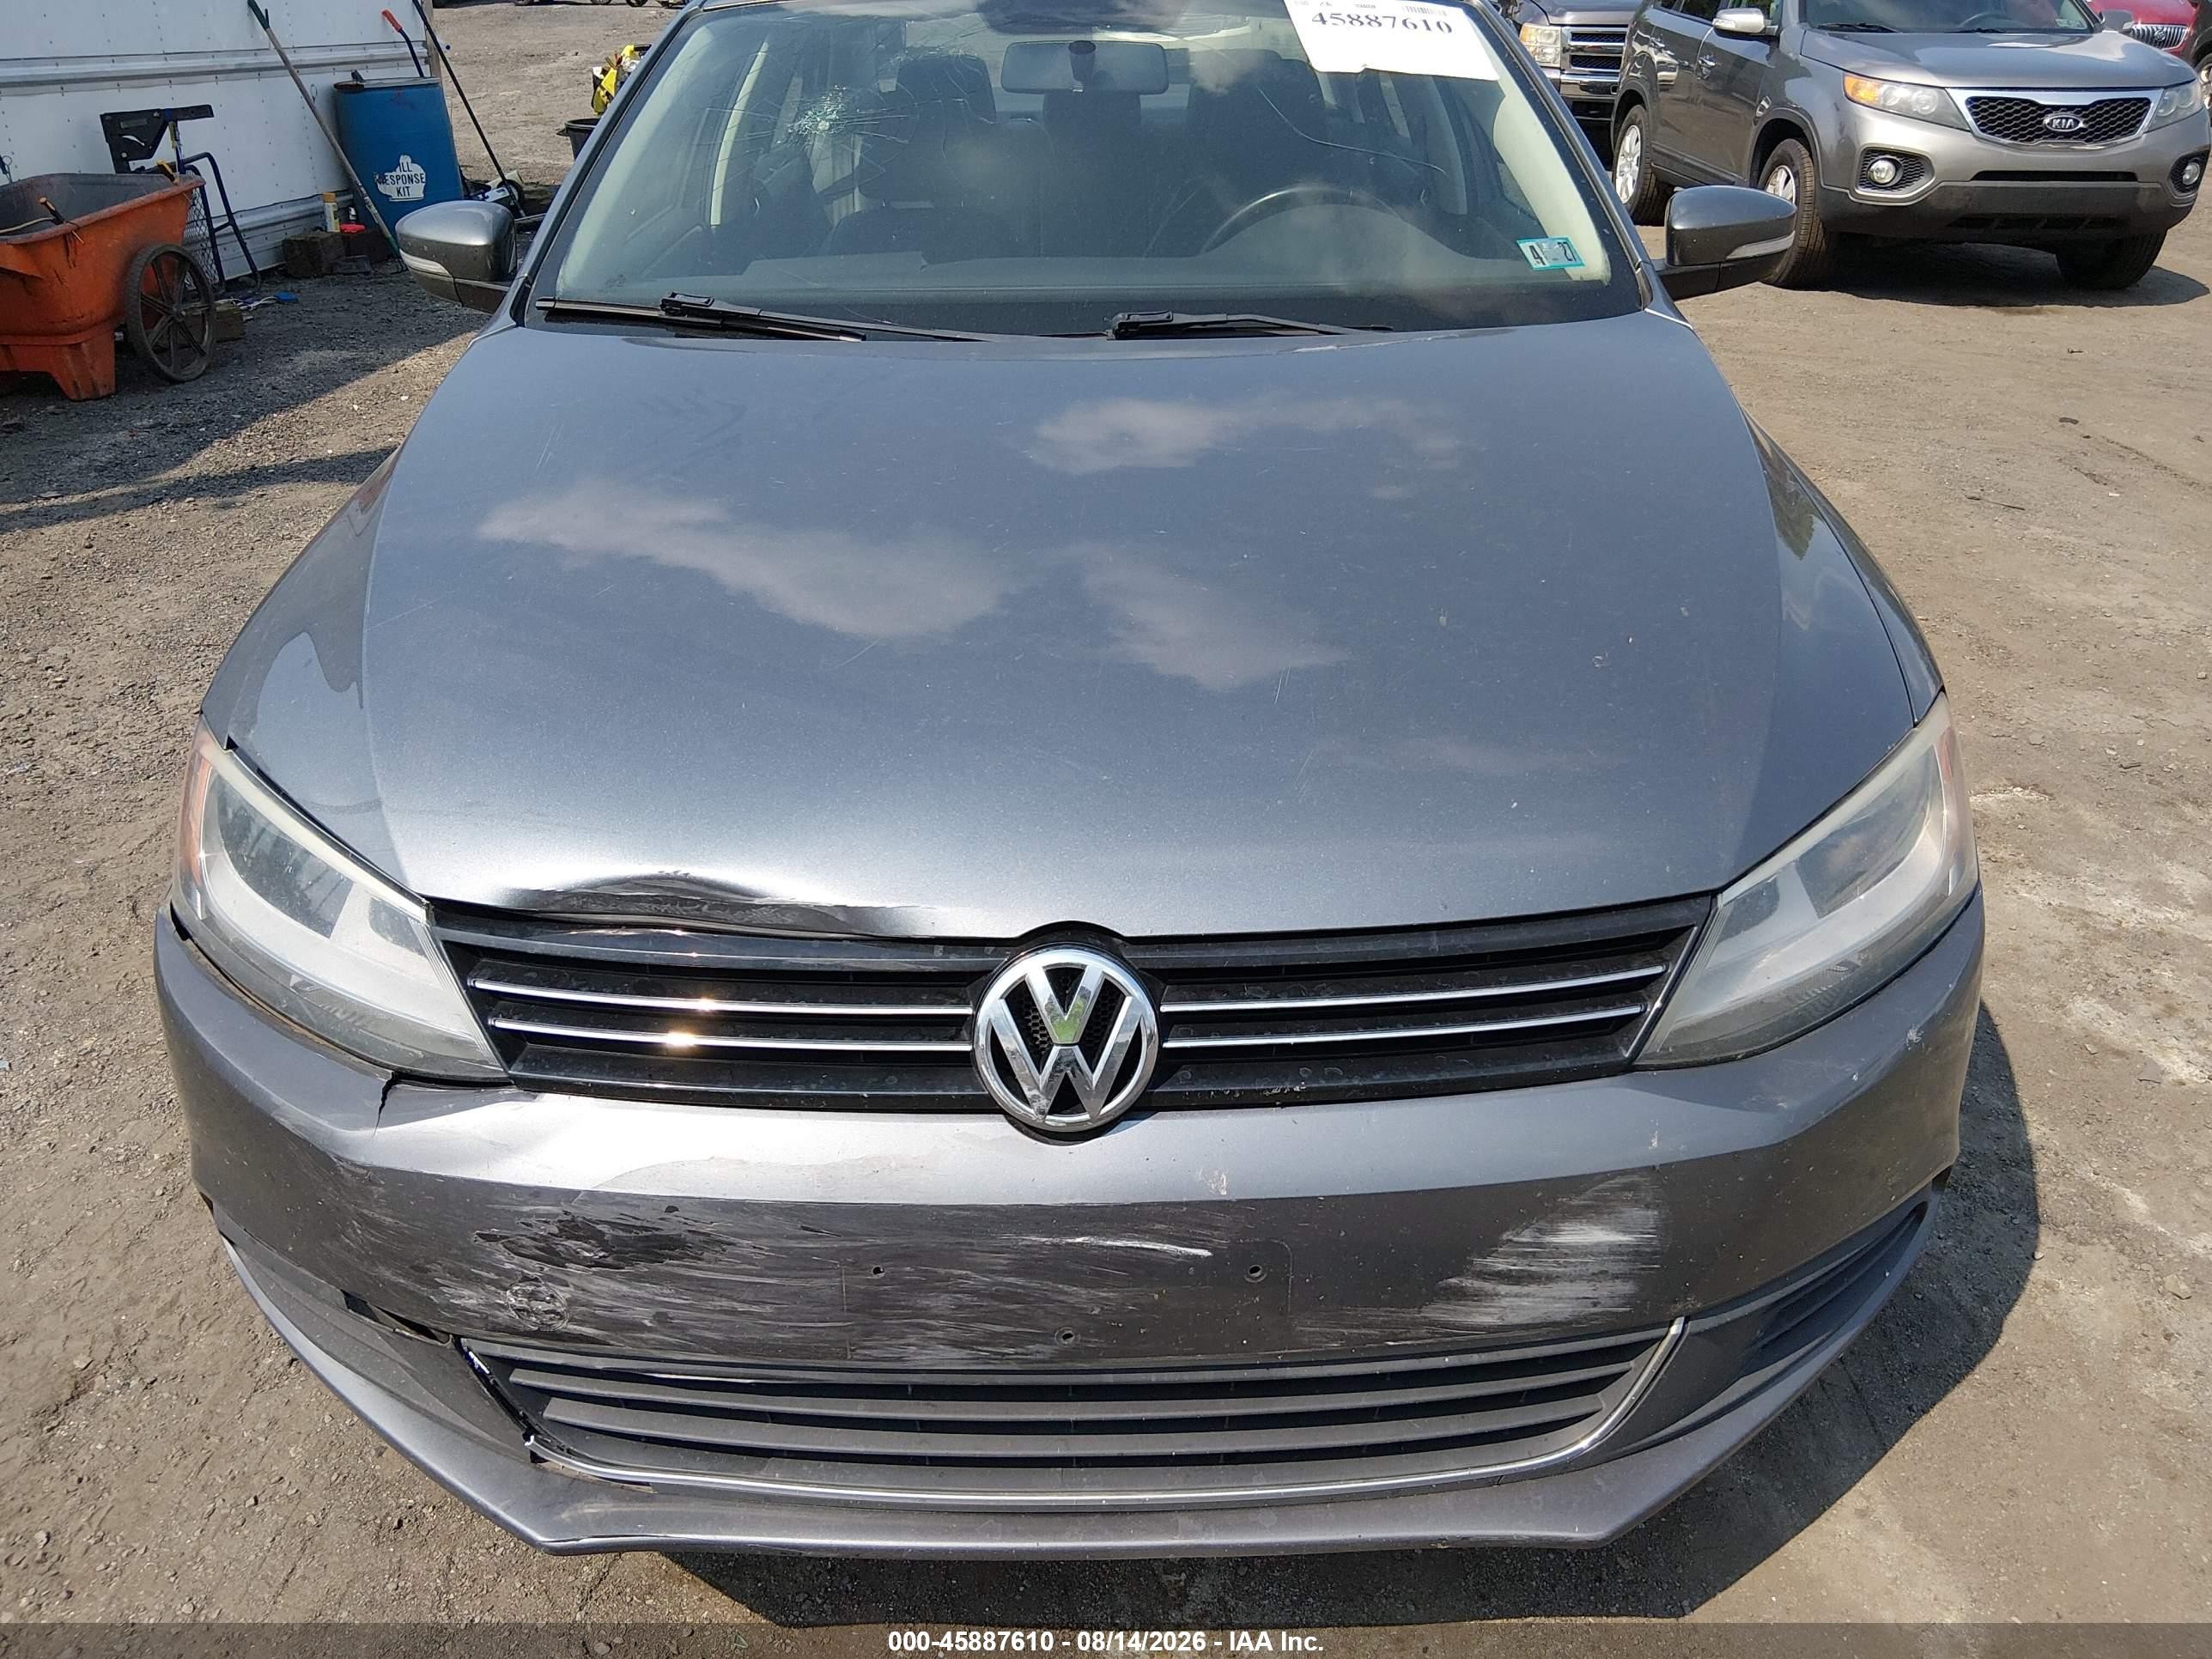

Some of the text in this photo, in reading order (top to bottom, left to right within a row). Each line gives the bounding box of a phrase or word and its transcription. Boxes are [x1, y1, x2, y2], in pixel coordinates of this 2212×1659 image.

[1311, 12, 1453, 33] 45887610
[2051, 118, 2075, 129] KIA
[396, 185, 411, 197] KIT
[1528, 245, 1547, 266] 4
[980, 950, 1154, 1127] VW
